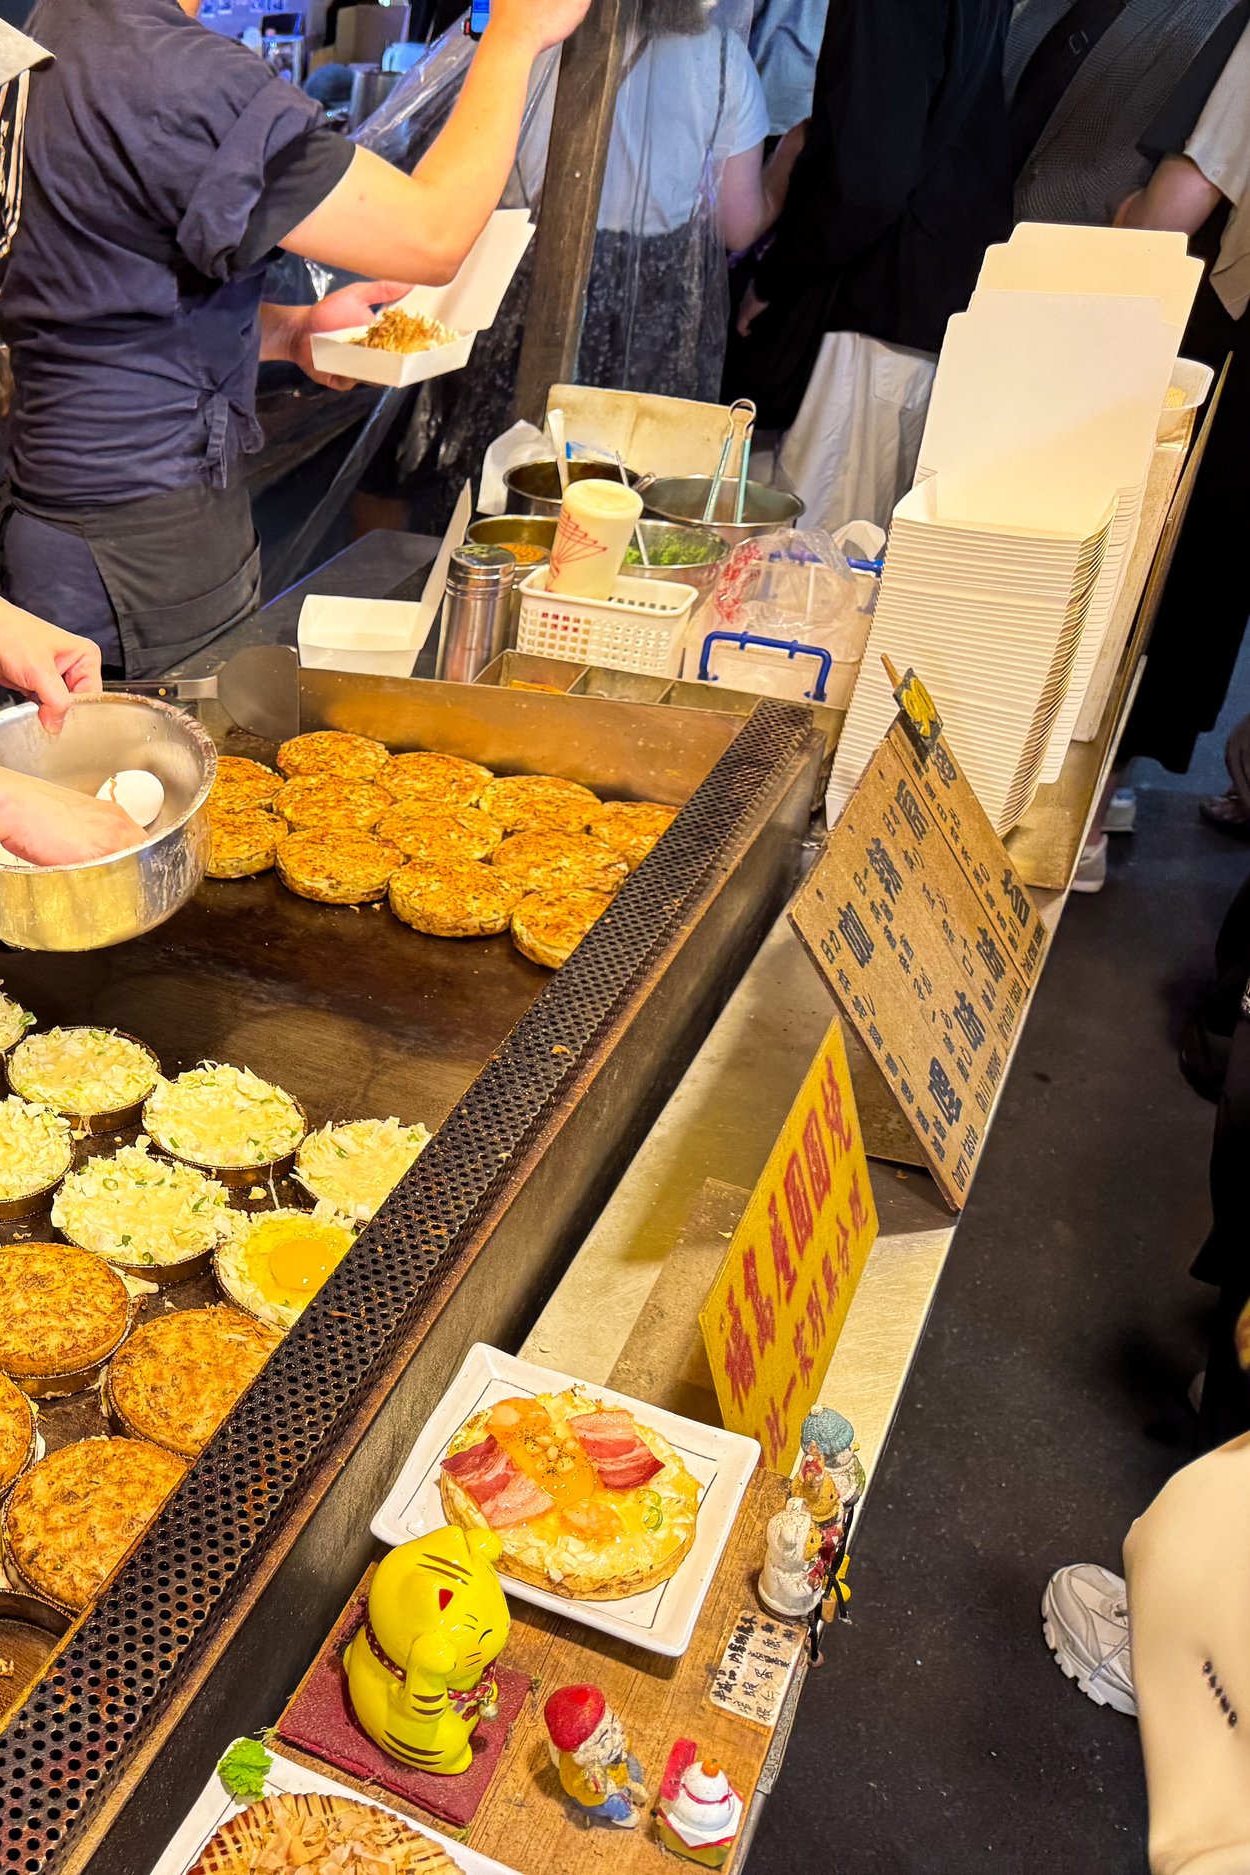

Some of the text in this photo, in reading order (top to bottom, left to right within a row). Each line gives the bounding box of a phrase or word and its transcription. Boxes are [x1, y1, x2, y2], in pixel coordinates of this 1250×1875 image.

[867, 837, 986, 1051] 辣味
[894, 779, 1007, 983] 原味
[838, 901, 962, 1126] 咖哩
[997, 977, 1023, 1042] Original taste
[952, 1124, 979, 1192] Curry taste
[975, 1075, 992, 1113] Chili
